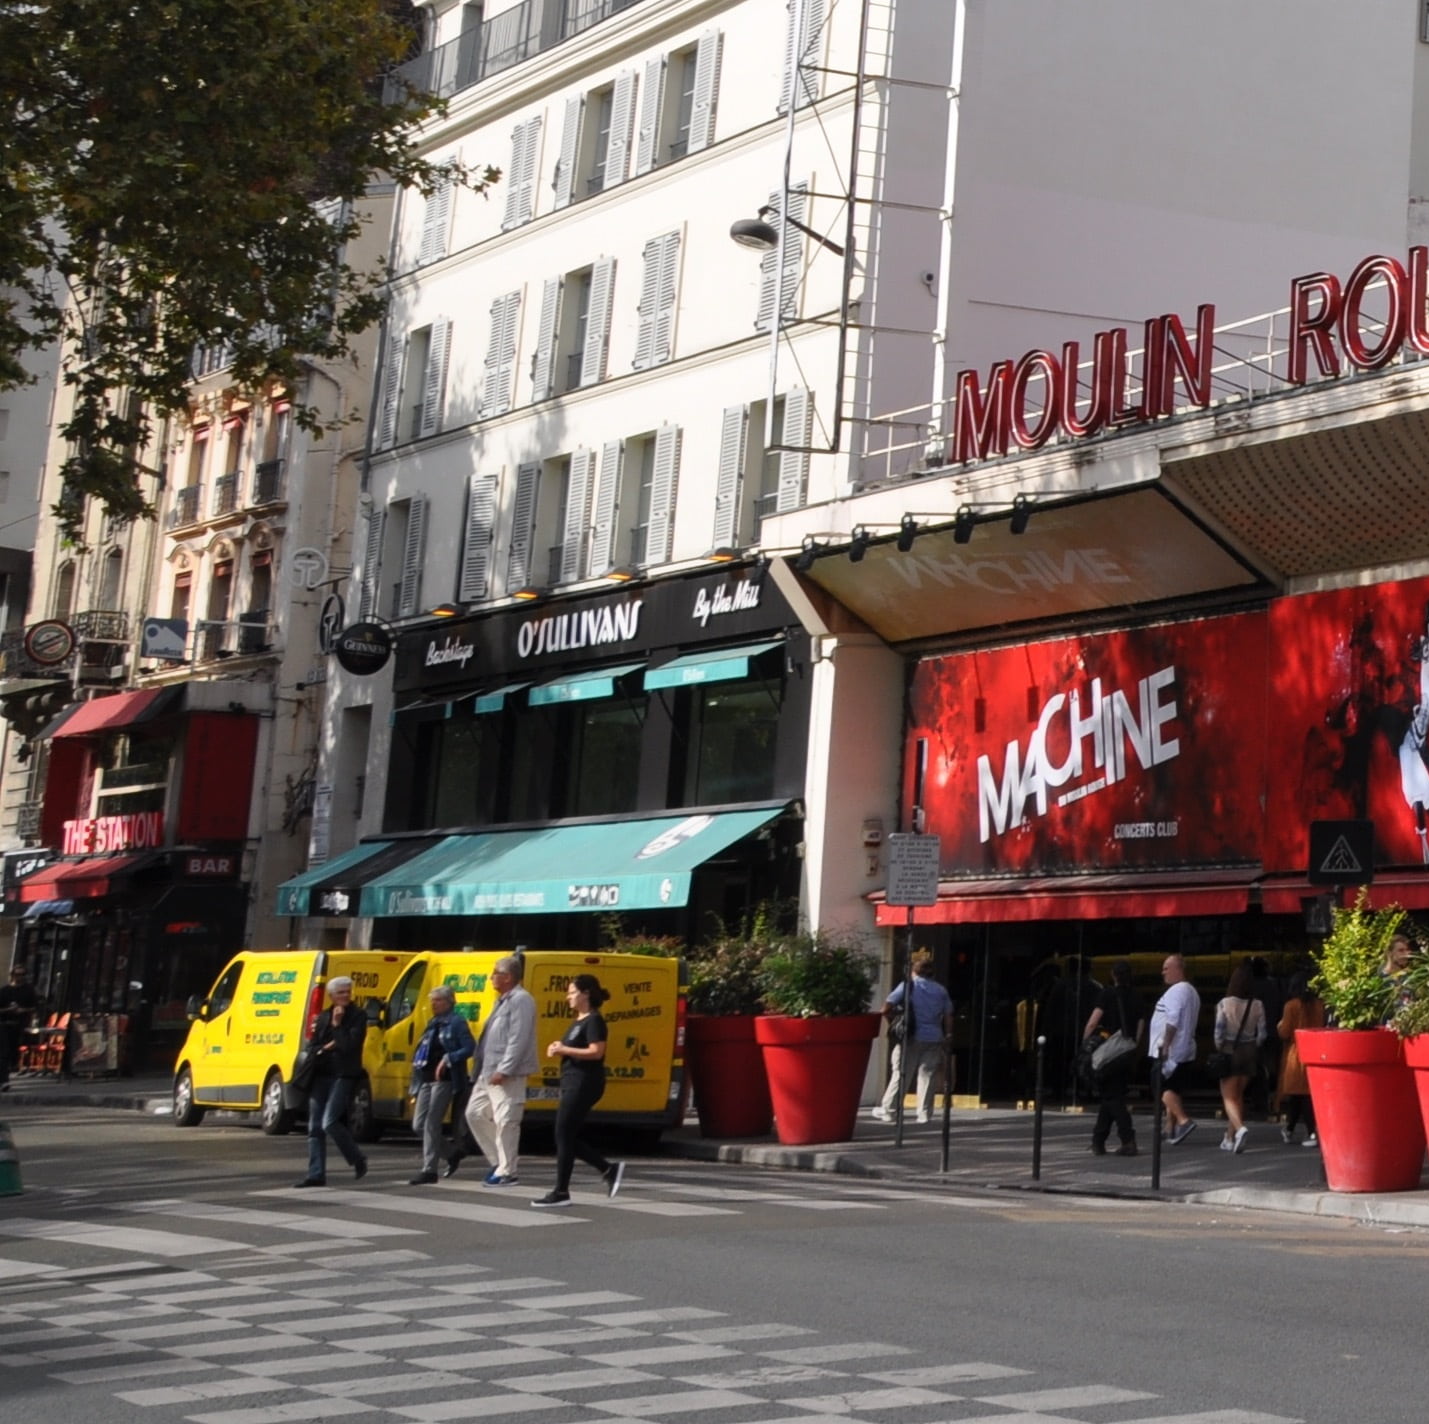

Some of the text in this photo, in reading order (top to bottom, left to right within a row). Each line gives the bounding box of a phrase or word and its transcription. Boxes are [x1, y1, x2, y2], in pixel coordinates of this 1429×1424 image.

[951, 303, 1215, 463] MOULIN
[693, 580, 759, 628] By the Mill
[517, 599, 643, 659] O'SULLIVANS
[425, 636, 475, 669] Backstage
[977, 665, 1180, 843] MACHINE
[63, 812, 157, 855] THE STATION
[1114, 821, 1178, 839] CONCERTS CLUB
[189, 859, 230, 873] BAR
[624, 981, 652, 994] VENTE
[633, 996, 639, 1006] &
